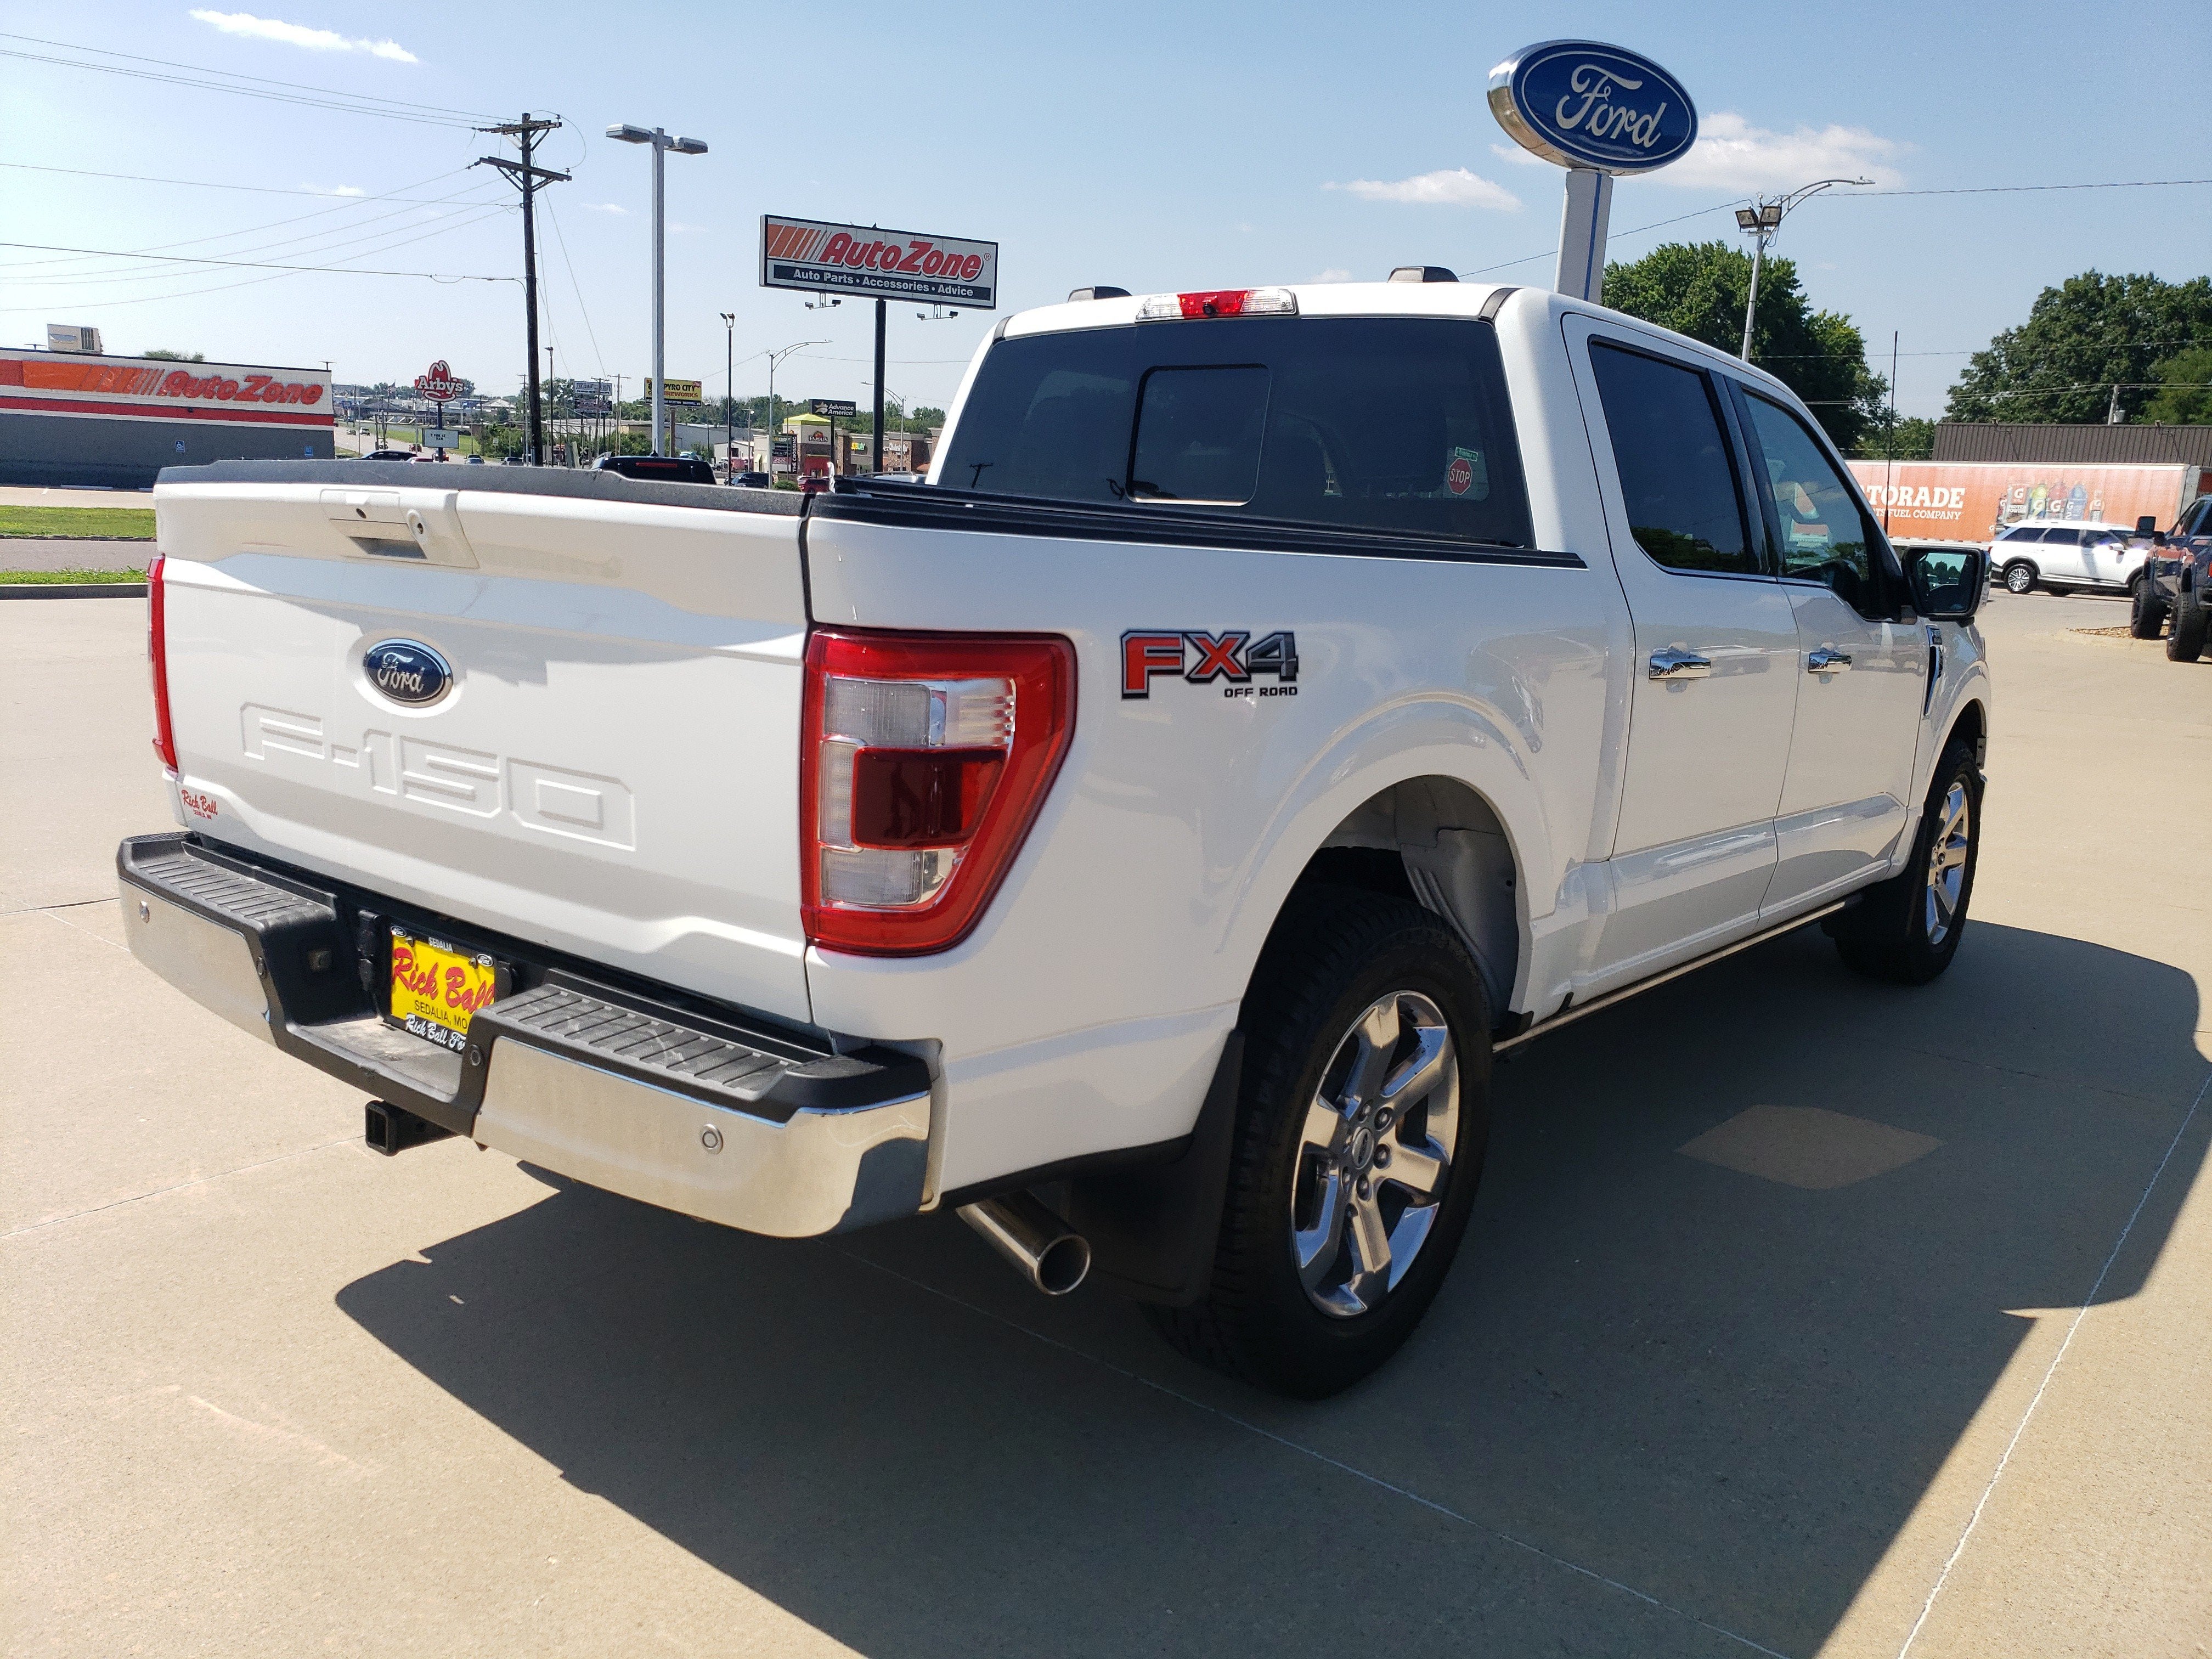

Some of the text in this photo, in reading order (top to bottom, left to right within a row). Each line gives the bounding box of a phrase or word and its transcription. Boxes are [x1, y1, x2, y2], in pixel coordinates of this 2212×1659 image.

[1555, 63, 1667, 148] Ford
[818, 232, 984, 282] AutoZone
[793, 268, 973, 296] Auto Parts Accessories Advice
[156, 370, 323, 405] AutoZone
[417, 376, 464, 394] Arby's
[1450, 469, 1470, 484] STOP
[1860, 485, 1966, 509] TORADE
[1888, 509, 1911, 518] FUEL
[1913, 510, 1961, 520] COMPANY
[377, 652, 426, 693] Ford
[1120, 629, 1299, 699] FX4
[1224, 686, 1298, 697] OFF ROAD
[240, 702, 636, 851] F-150
[182, 789, 200, 809] Rick
[200, 795, 218, 815] Ball
[428, 936, 453, 953] SEDALIA
[391, 947, 494, 1014] Rick Ball
[415, 1000, 467, 1029] SEDALIA, MO
[405, 1013, 466, 1050] Rick Ball Fo
